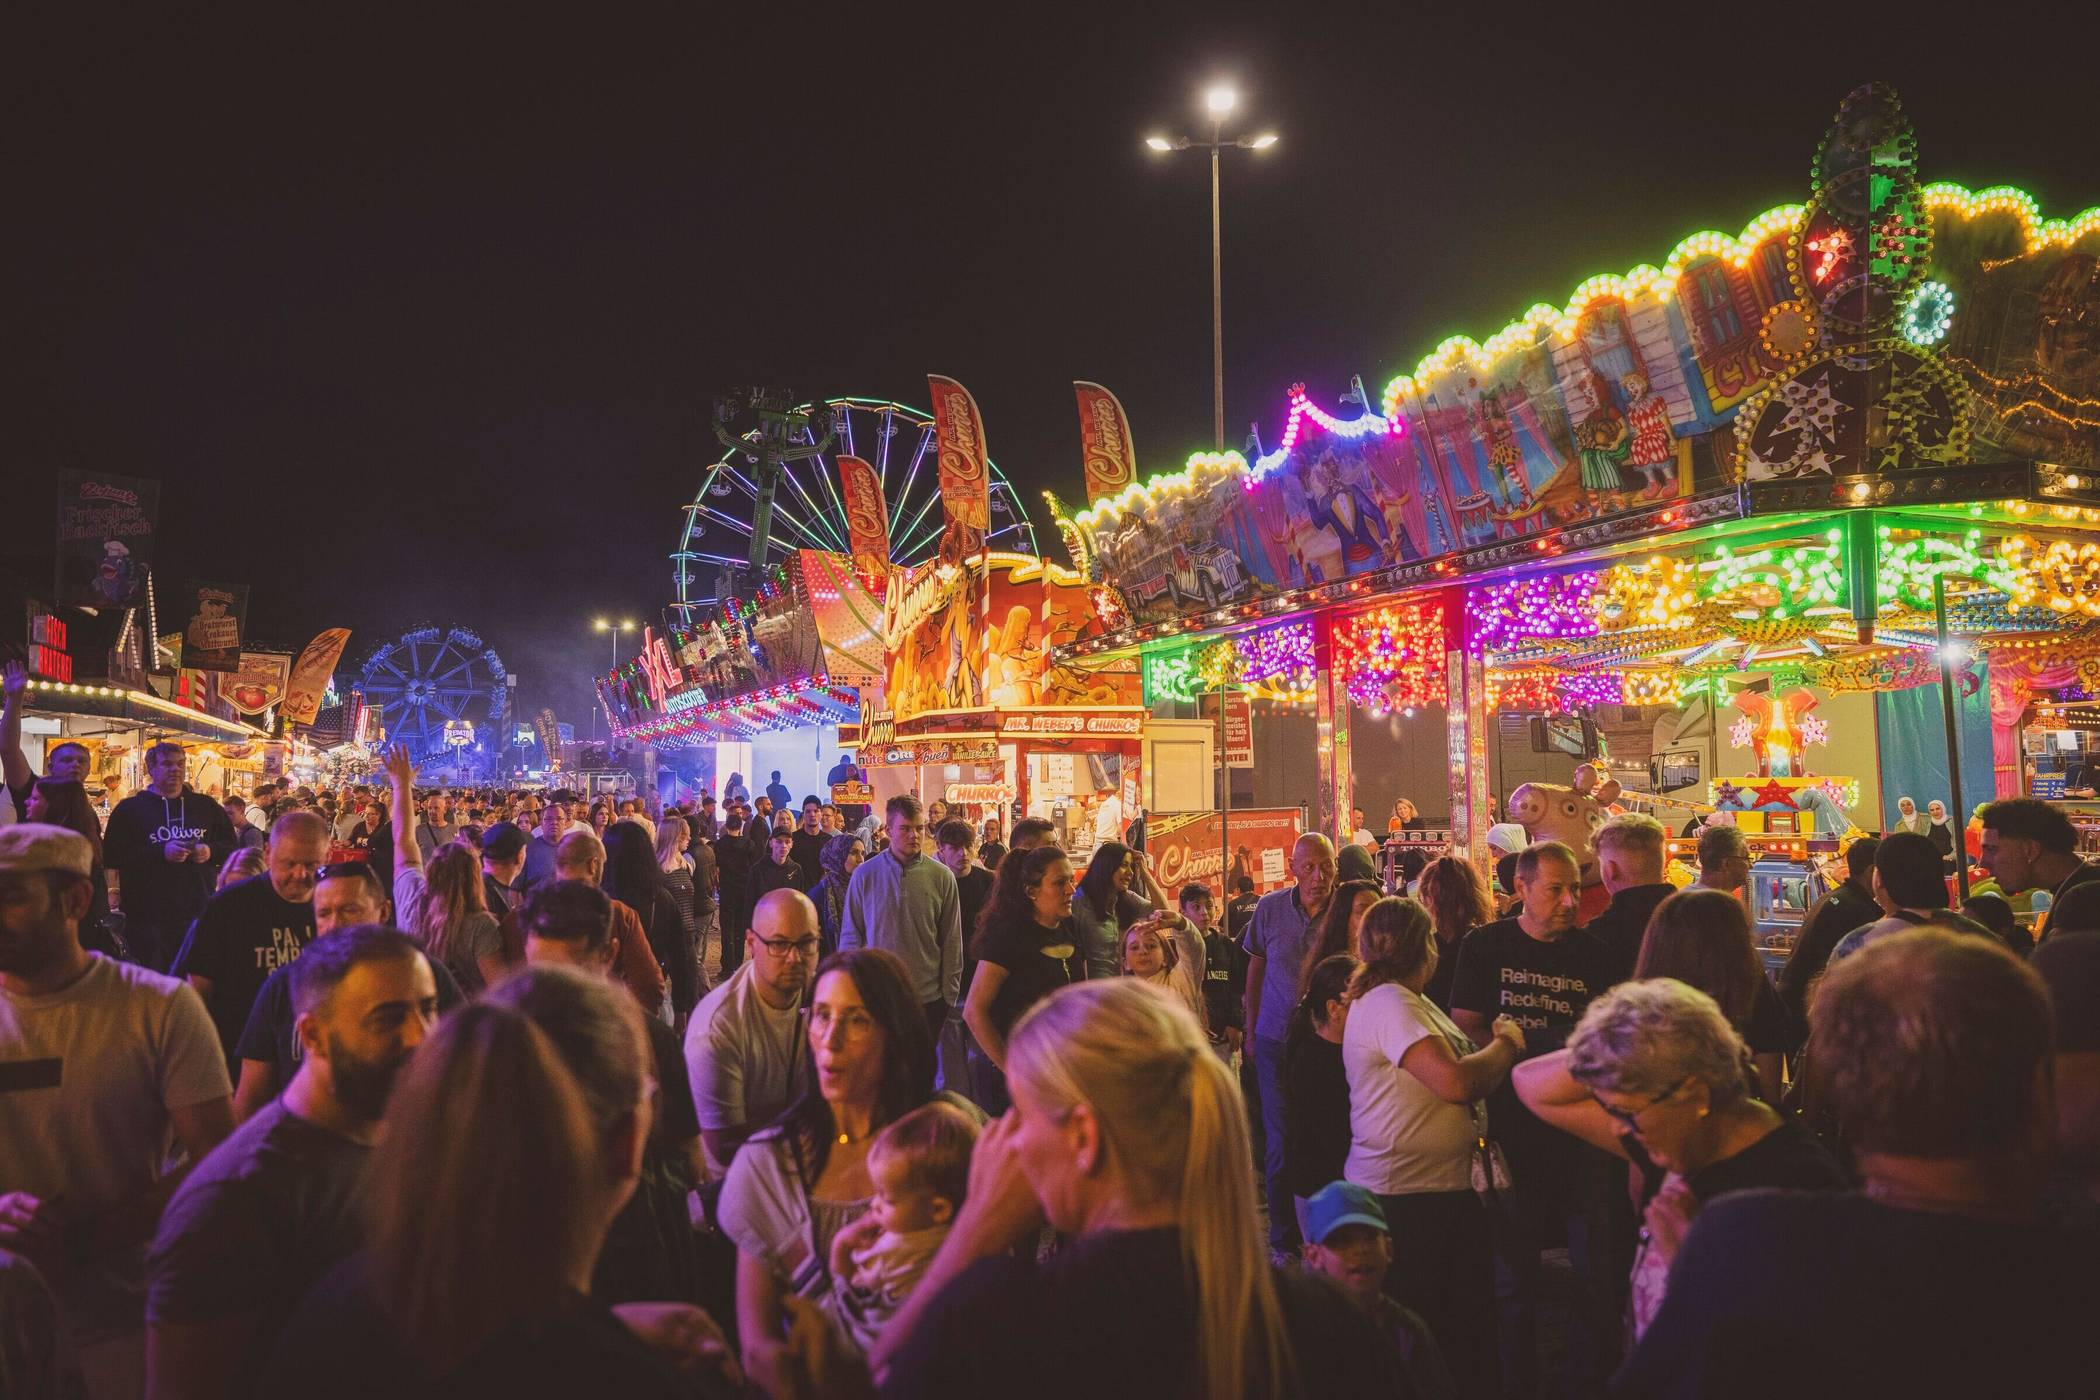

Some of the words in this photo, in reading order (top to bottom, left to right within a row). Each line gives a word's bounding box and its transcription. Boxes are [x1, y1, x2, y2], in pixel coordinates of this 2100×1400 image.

[1003, 717, 1030, 731] MR.
[1032, 716, 1084, 731] WEBER'S
[1087, 718, 1140, 731] CHURROS
[1213, 754, 1248, 762] PRTEI
[946, 784, 1018, 804] CHURROS
[150, 826, 207, 843] s.Oliver
[255, 947, 304, 969] TEMP
[1501, 967, 1588, 995] Reimagine,
[1500, 990, 1574, 1016] Redefine,
